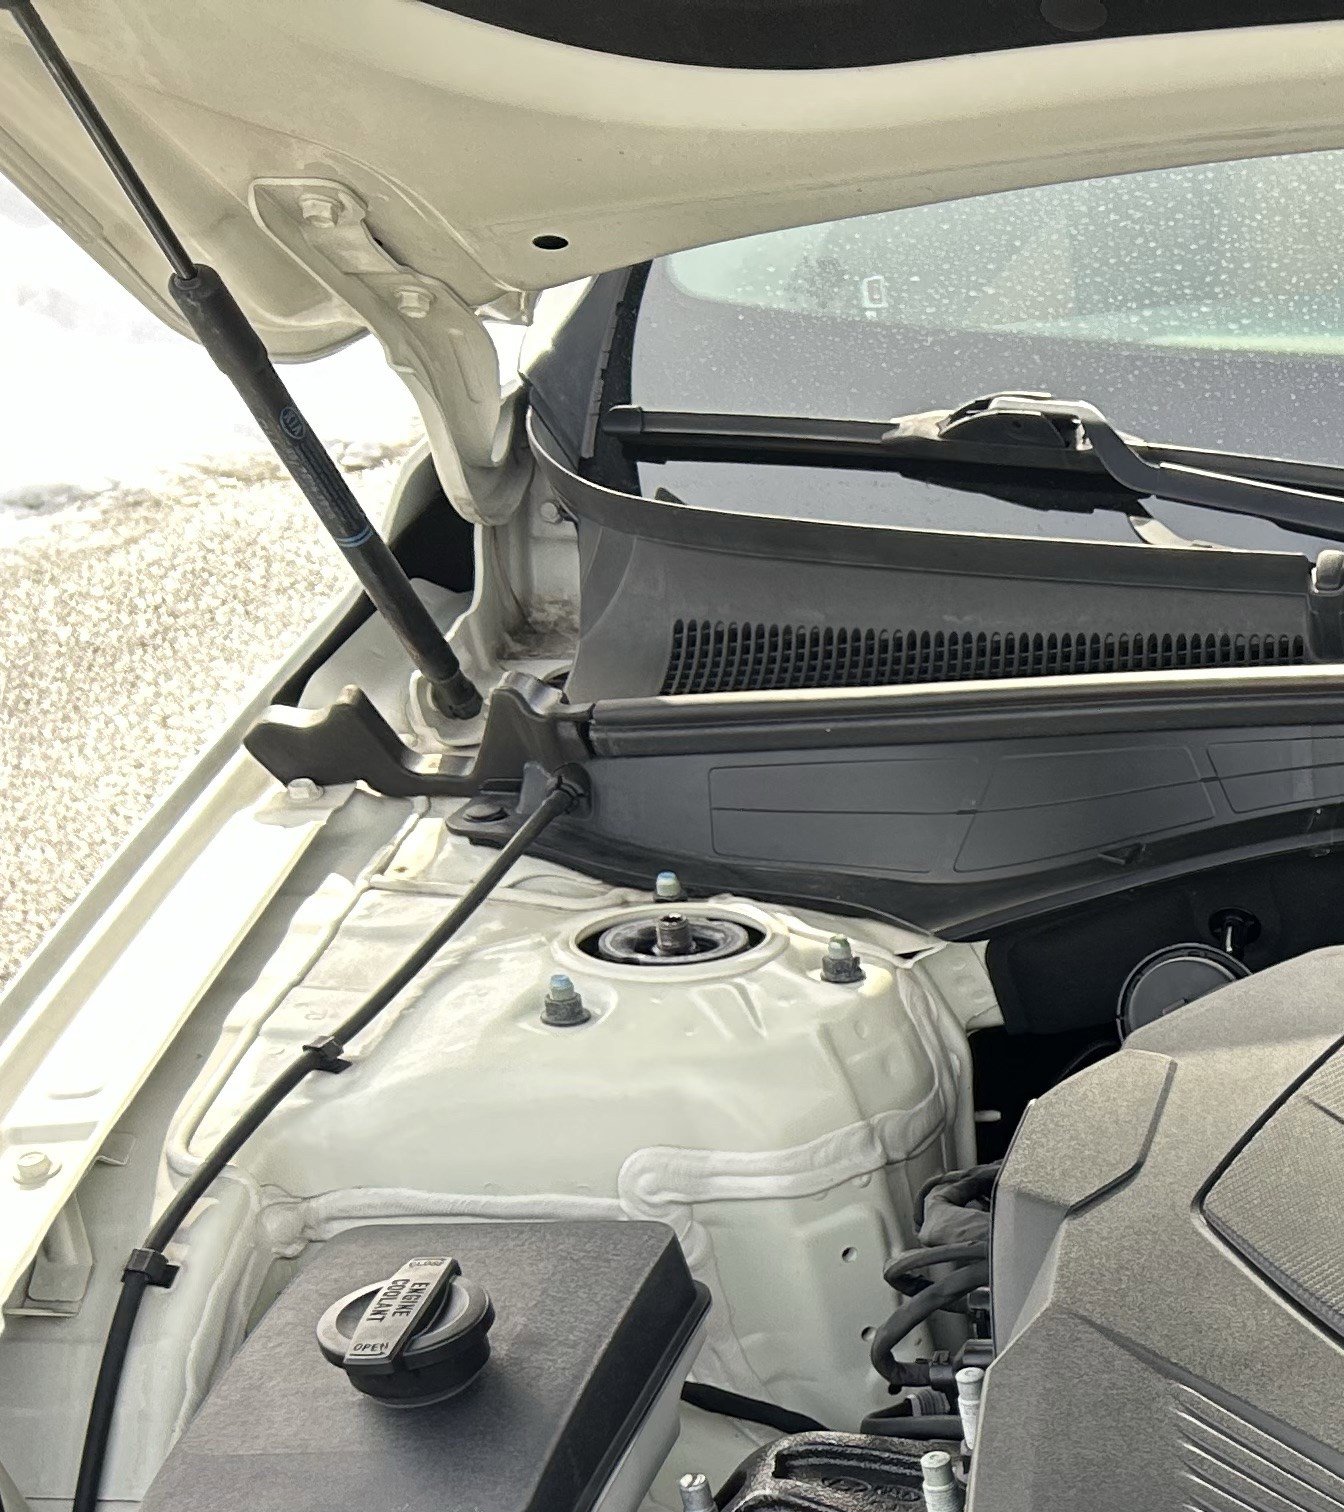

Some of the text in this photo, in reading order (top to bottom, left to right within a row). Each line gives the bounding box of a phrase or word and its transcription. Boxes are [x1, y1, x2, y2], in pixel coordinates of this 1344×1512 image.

[366, 1278, 411, 1324] COOLANT
[391, 1281, 431, 1318] ENGINE
[353, 1341, 390, 1352] OPEN
